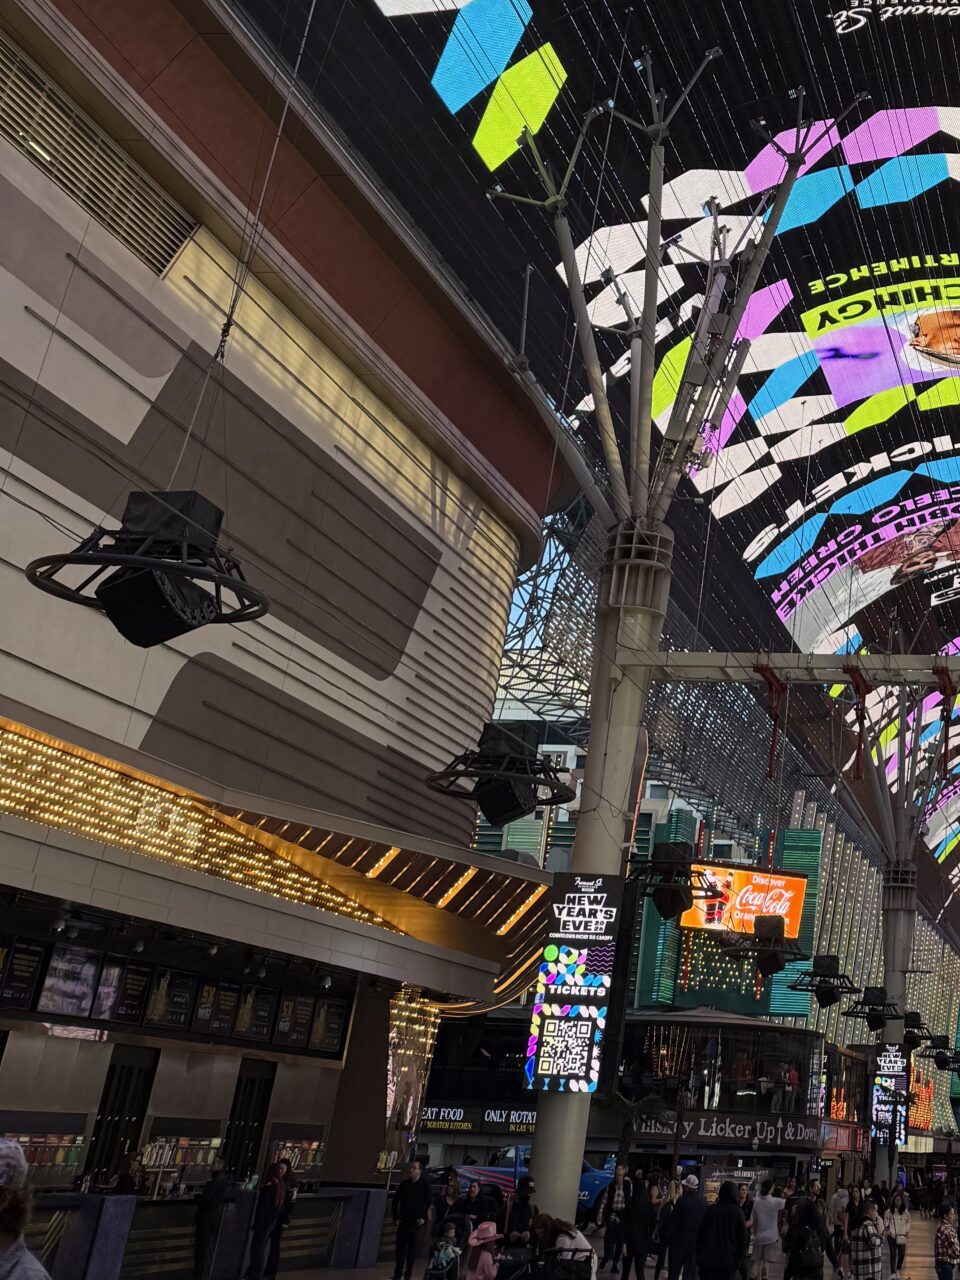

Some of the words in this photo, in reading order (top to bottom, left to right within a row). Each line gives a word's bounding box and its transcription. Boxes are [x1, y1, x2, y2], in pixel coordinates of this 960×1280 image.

[780, 533, 888, 619] THICKE
[752, 875, 787, 887] Discover
[566, 895, 605, 907] NEW
[556, 905, 614, 920] YEAR'S
[561, 920, 593, 932] EVE
[548, 985, 606, 996] TICKETS
[439, 1108, 464, 1121] FOOD
[484, 1109, 508, 1123] ONLY
[698, 1117, 752, 1138] Licker
[755, 1121, 775, 1144] Up
[784, 1122, 795, 1141] &
[797, 1123, 818, 1142] Down
